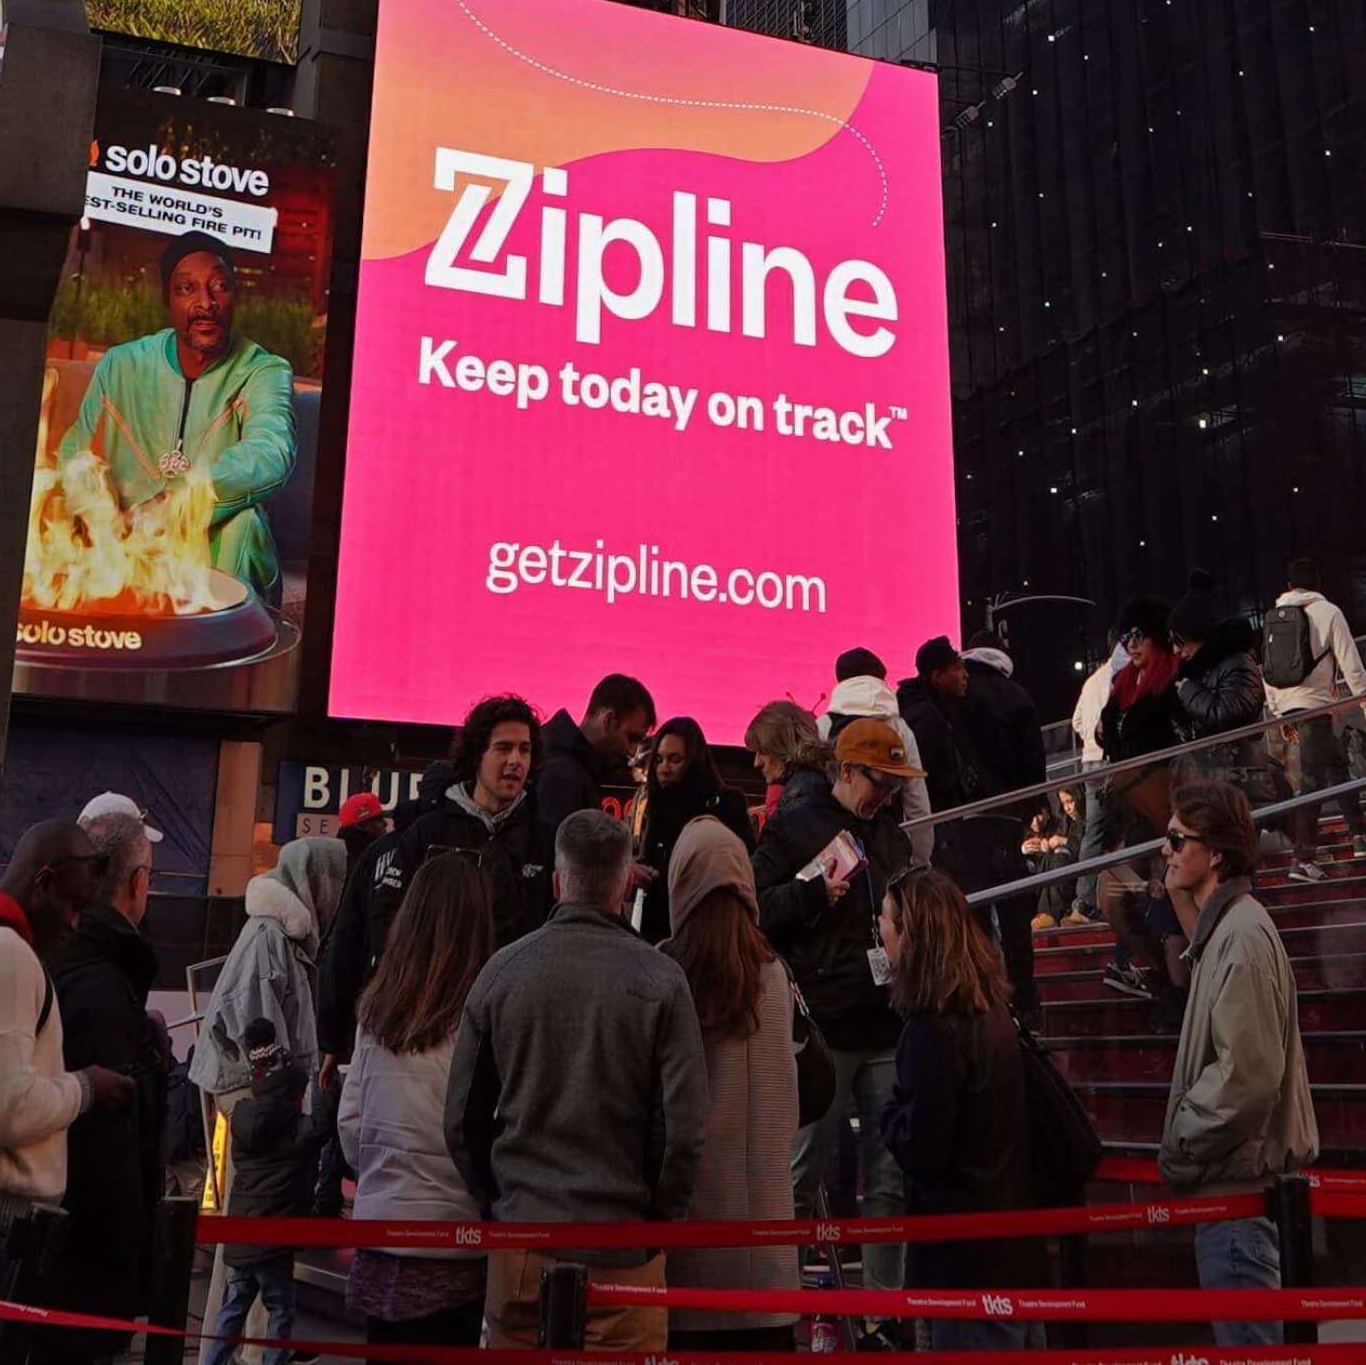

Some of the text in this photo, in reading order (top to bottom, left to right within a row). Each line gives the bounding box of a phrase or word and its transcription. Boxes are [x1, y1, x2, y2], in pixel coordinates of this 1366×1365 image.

[105, 144, 270, 196] solo stove
[112, 186, 224, 218] THE WORLD'S
[191, 217, 228, 234] FIRE
[232, 224, 262, 240] PIT!
[424, 145, 898, 359] Zipline
[417, 336, 550, 409] Keep
[559, 365, 698, 434] today
[707, 390, 766, 432] on
[485, 536, 827, 615] getzipline.com
[68, 624, 142, 649] stove
[1146, 1205, 1171, 1224] tkts
[455, 1226, 482, 1245] tkts
[816, 1222, 841, 1242] tkts
[981, 1293, 1013, 1316] tkts
